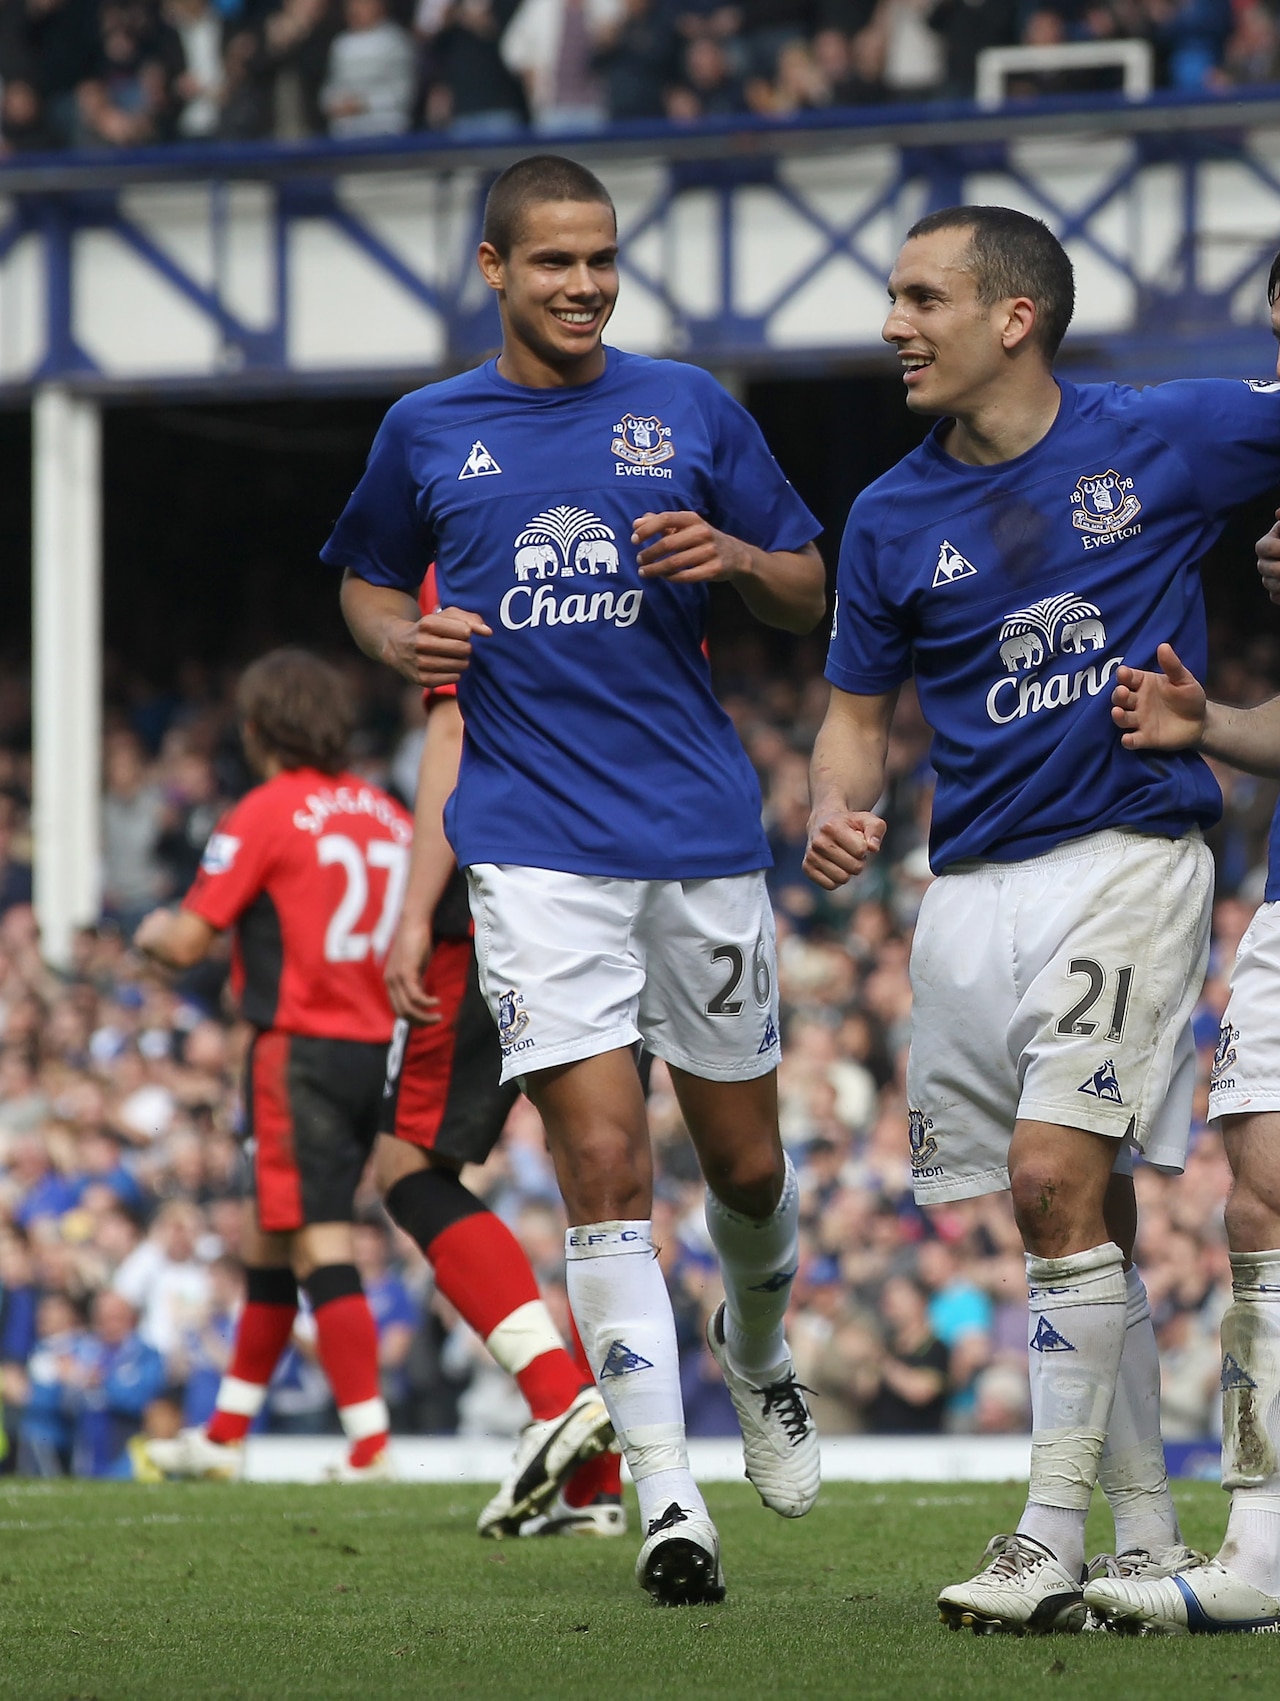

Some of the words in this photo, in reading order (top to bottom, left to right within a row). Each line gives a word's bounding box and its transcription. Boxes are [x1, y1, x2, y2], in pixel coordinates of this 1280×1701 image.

[615, 462, 672, 479] Everton
[1069, 491, 1082, 503] 18
[1120, 477, 1134, 491] 78
[1081, 523, 1142, 550] Everton
[499, 584, 643, 630] Chang
[316, 833, 411, 965] 27
[704, 940, 772, 1015] 26
[1053, 956, 1136, 1044] 21
